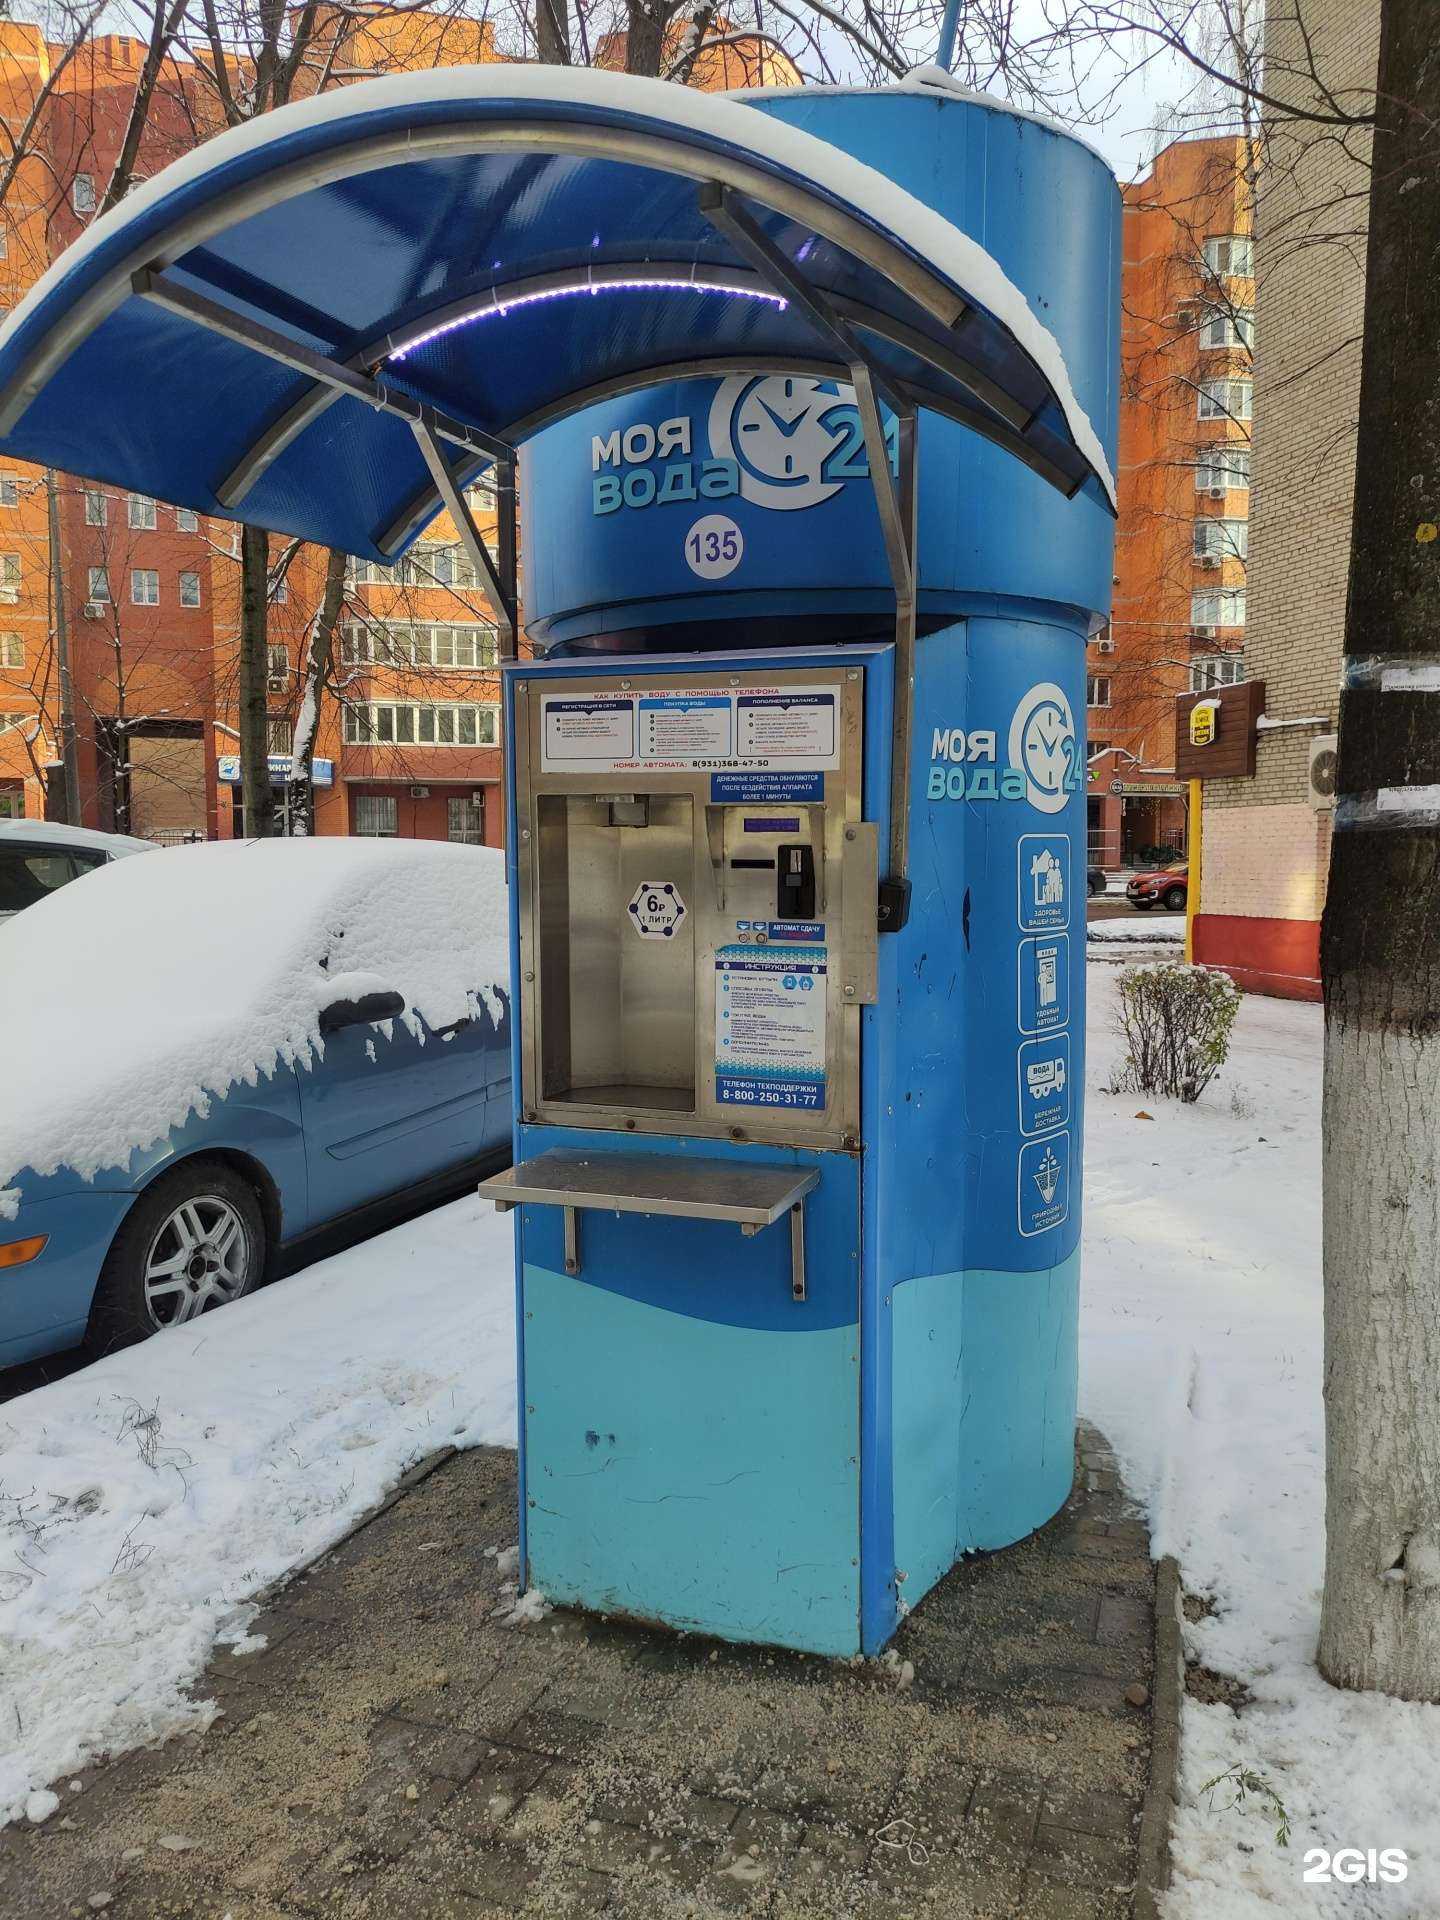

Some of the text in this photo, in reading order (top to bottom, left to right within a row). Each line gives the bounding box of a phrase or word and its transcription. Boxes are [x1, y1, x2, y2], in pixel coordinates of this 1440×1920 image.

[592, 416, 692, 472] МОЯ
[689, 530, 738, 563] 135
[648, 691, 671, 699] ВОДУ
[685, 689, 730, 697] ПОМОЩЬЮ
[735, 688, 780, 696] ТЕЛЕФОНА
[931, 727, 997, 763] МОЯ
[692, 759, 769, 769] 8(931)368-47-50
[1060, 735, 1084, 793] 24
[741, 783, 782, 791] БЕЗДЕЙСТВИЯ
[782, 783, 813, 791] АППАРАТА
[648, 915, 672, 924] ЛИТР
[800, 925, 821, 933] СДАЧУ
[744, 963, 798, 972] ИНСТРУКЦИЯ
[1033, 1064, 1050, 1075] ВОДА
[722, 1080, 817, 1093] ТЕЛЕФОН ТЕХПОДДЕРЖКИ
[722, 1089, 817, 1105] 8-800-250-31-77
